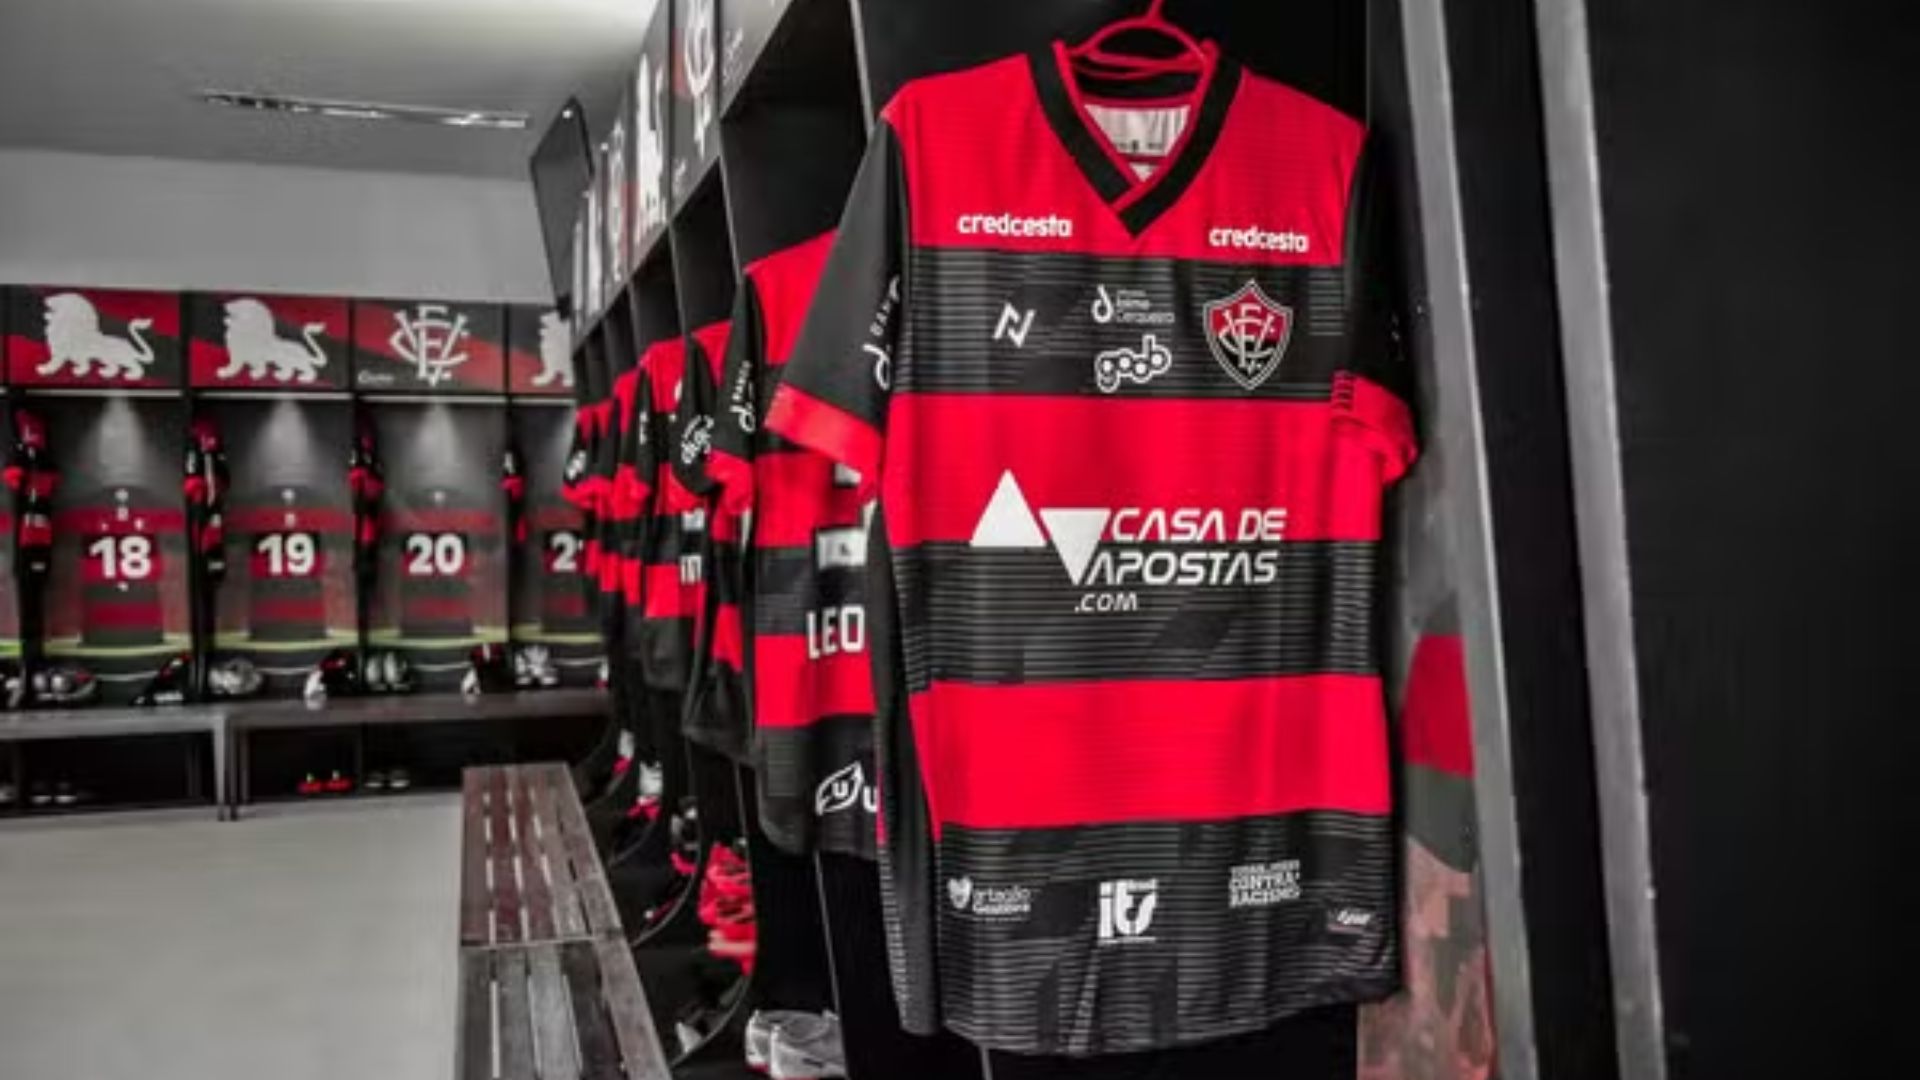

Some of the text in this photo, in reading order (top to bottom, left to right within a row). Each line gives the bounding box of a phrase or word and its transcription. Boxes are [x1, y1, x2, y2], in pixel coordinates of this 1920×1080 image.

[957, 213, 1072, 238] credcesta
[1209, 226, 1309, 253] credcesta
[1111, 508, 1287, 542] CASA DE
[90, 535, 151, 579] 18
[258, 533, 315, 575] 19
[408, 532, 464, 575] 20
[552, 532, 584, 572] 2
[1084, 551, 1279, 585] APOSTAS
[1074, 592, 1138, 613] .COM
[806, 604, 866, 660] LEO
